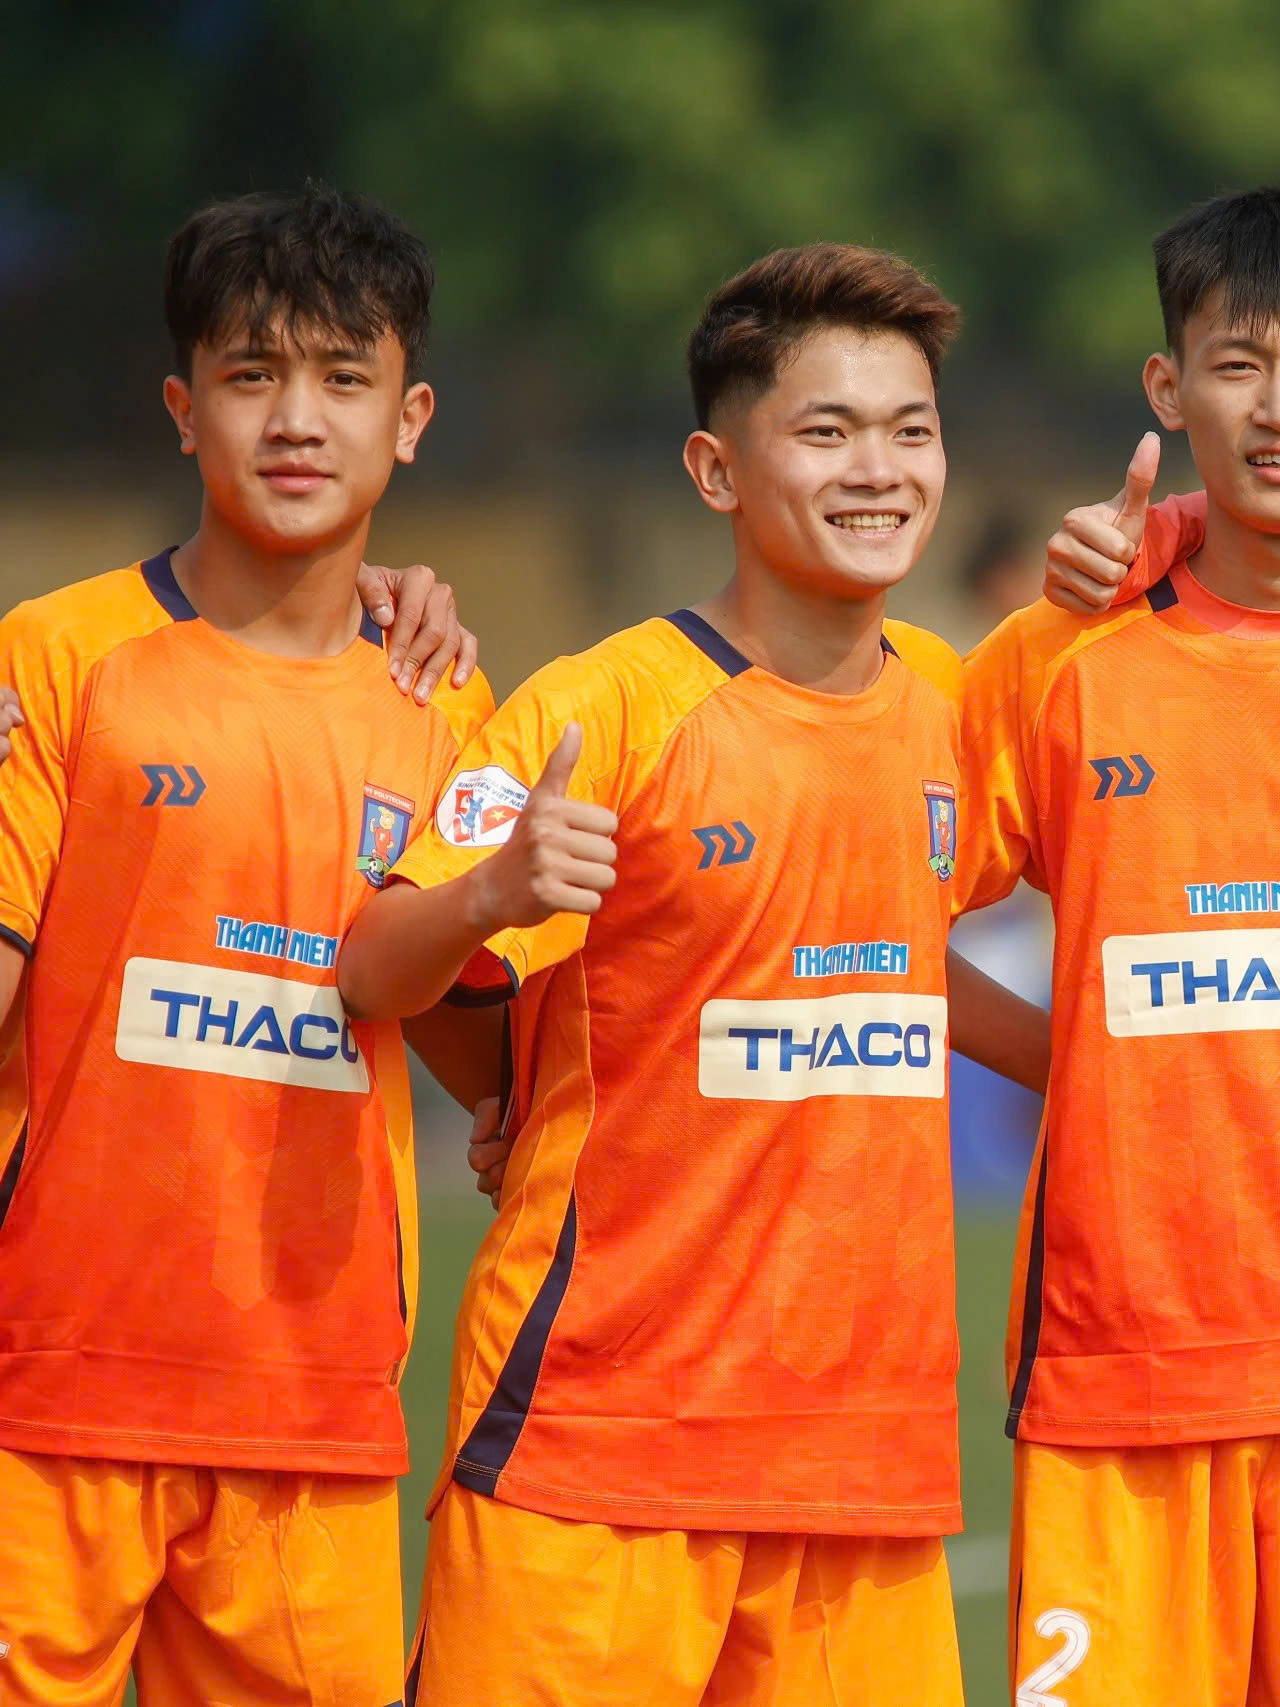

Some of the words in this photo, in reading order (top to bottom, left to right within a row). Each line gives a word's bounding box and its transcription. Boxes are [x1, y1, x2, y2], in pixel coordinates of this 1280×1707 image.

[1185, 883, 1269, 916] THANH
[216, 915, 290, 959] THANH
[286, 929, 339, 969] NIÊN
[793, 943, 856, 977] THANH
[855, 939, 908, 974] NIÊN
[728, 1022, 931, 1072] THACO
[1016, 1607, 1091, 1707] 2
